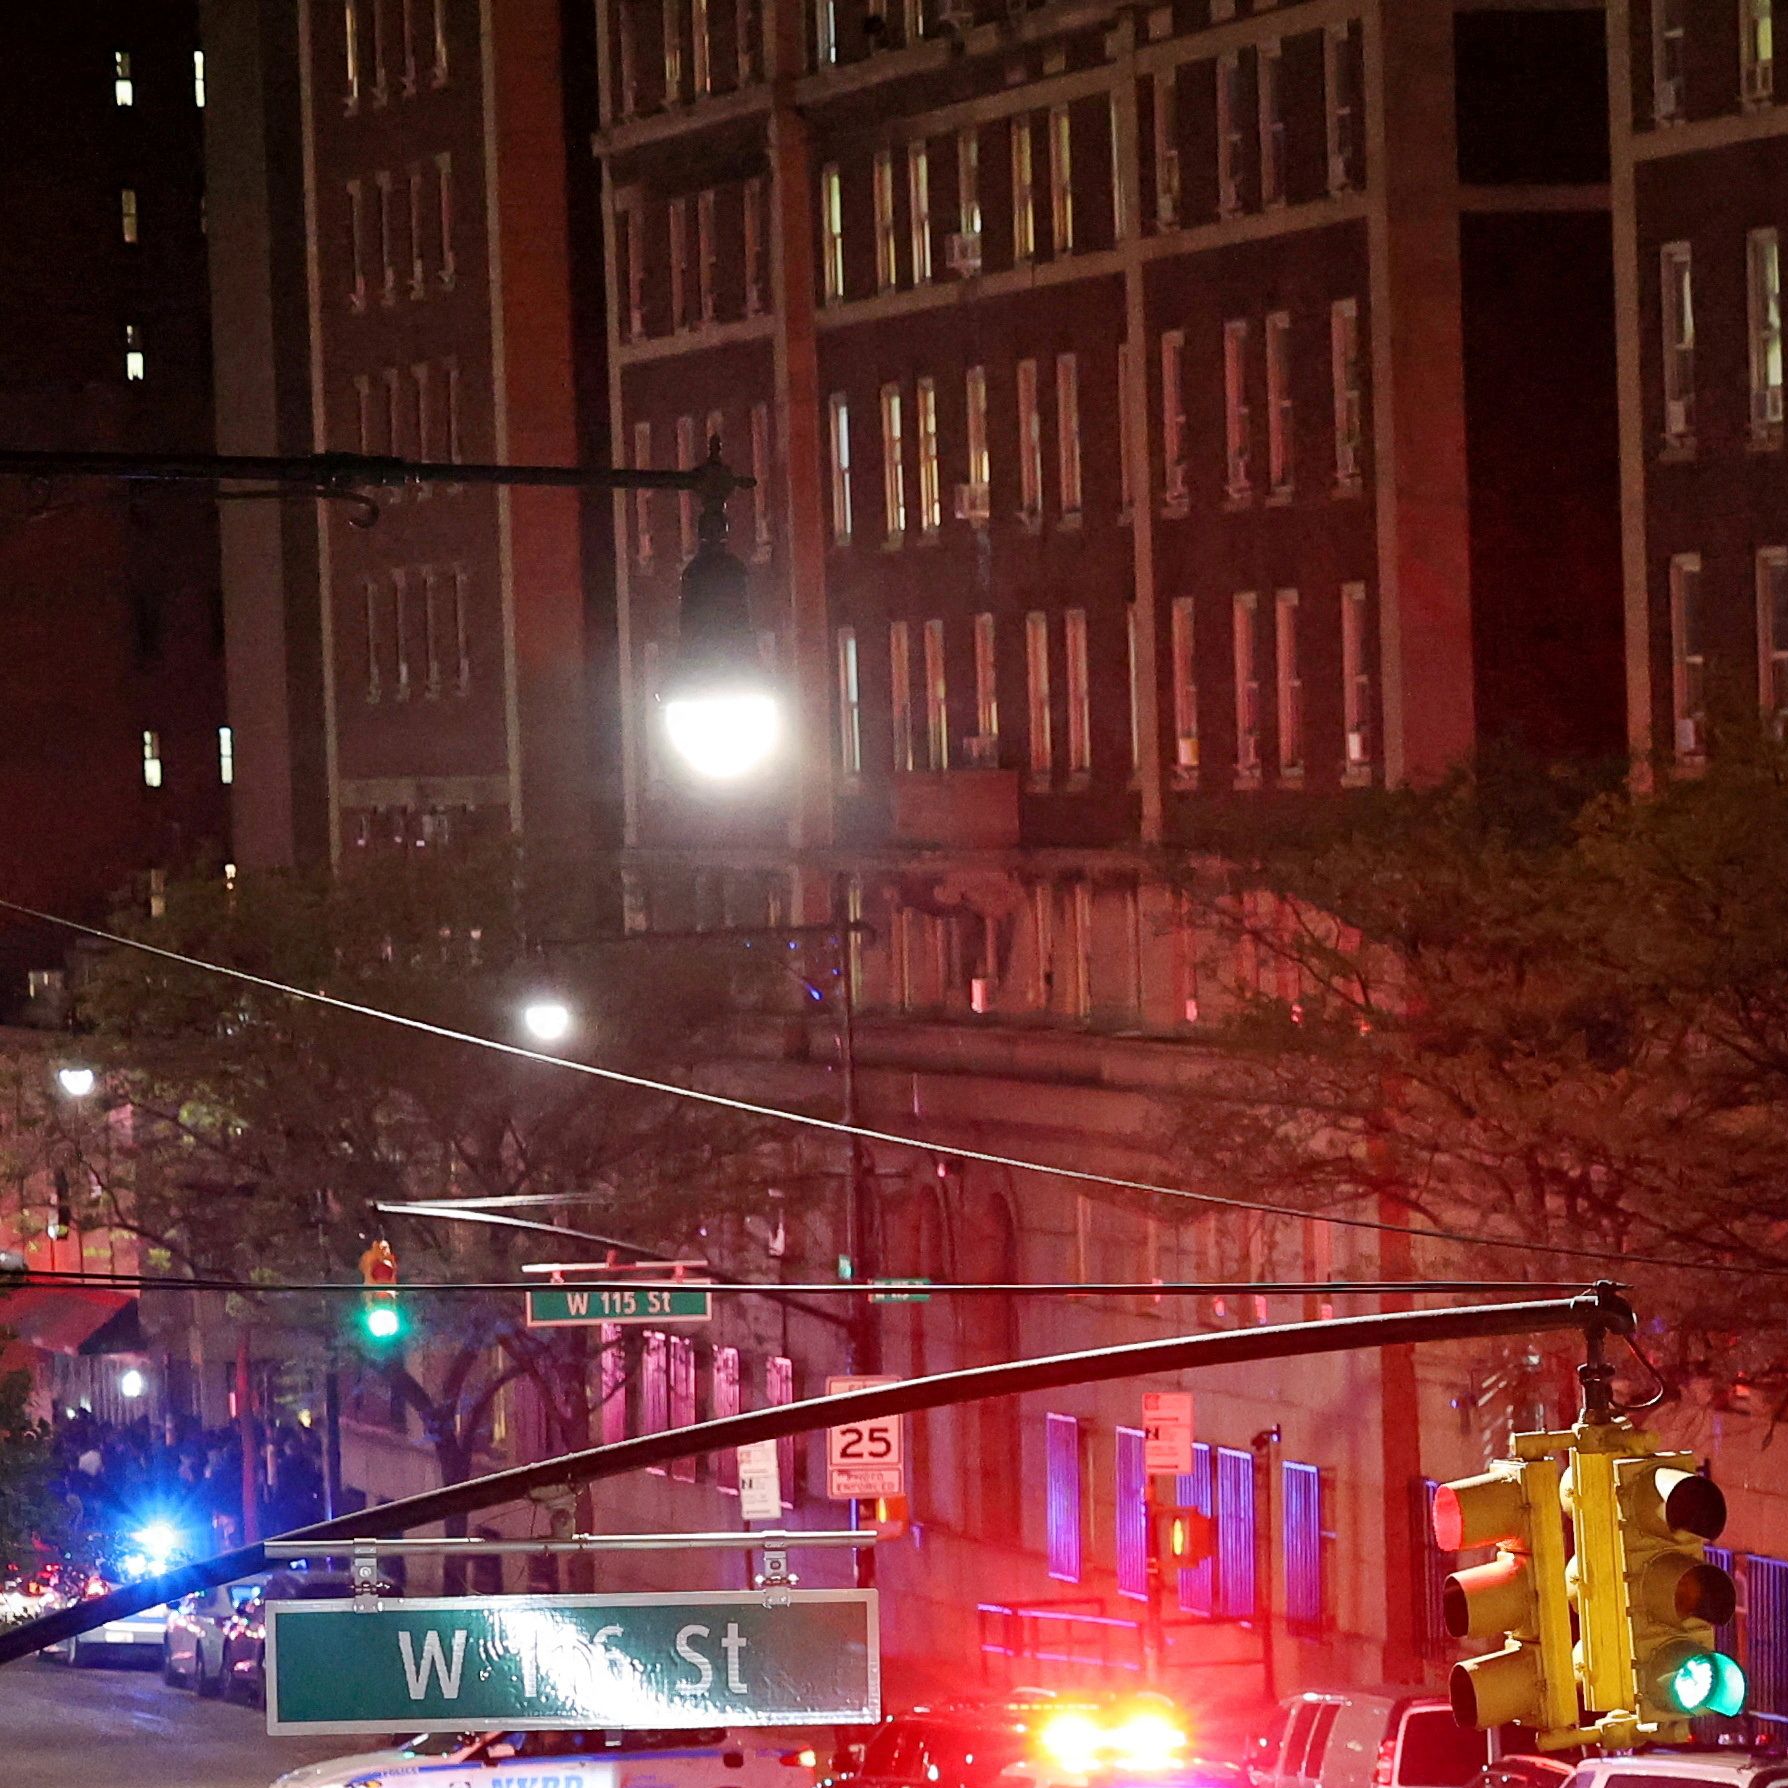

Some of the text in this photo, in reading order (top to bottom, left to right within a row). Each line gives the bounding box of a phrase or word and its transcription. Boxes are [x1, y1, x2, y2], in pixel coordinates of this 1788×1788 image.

[567, 1293, 671, 1315] W 115 St
[840, 1427, 891, 1458] 25
[399, 1629, 468, 1700] W
[675, 1622, 748, 1695] St
